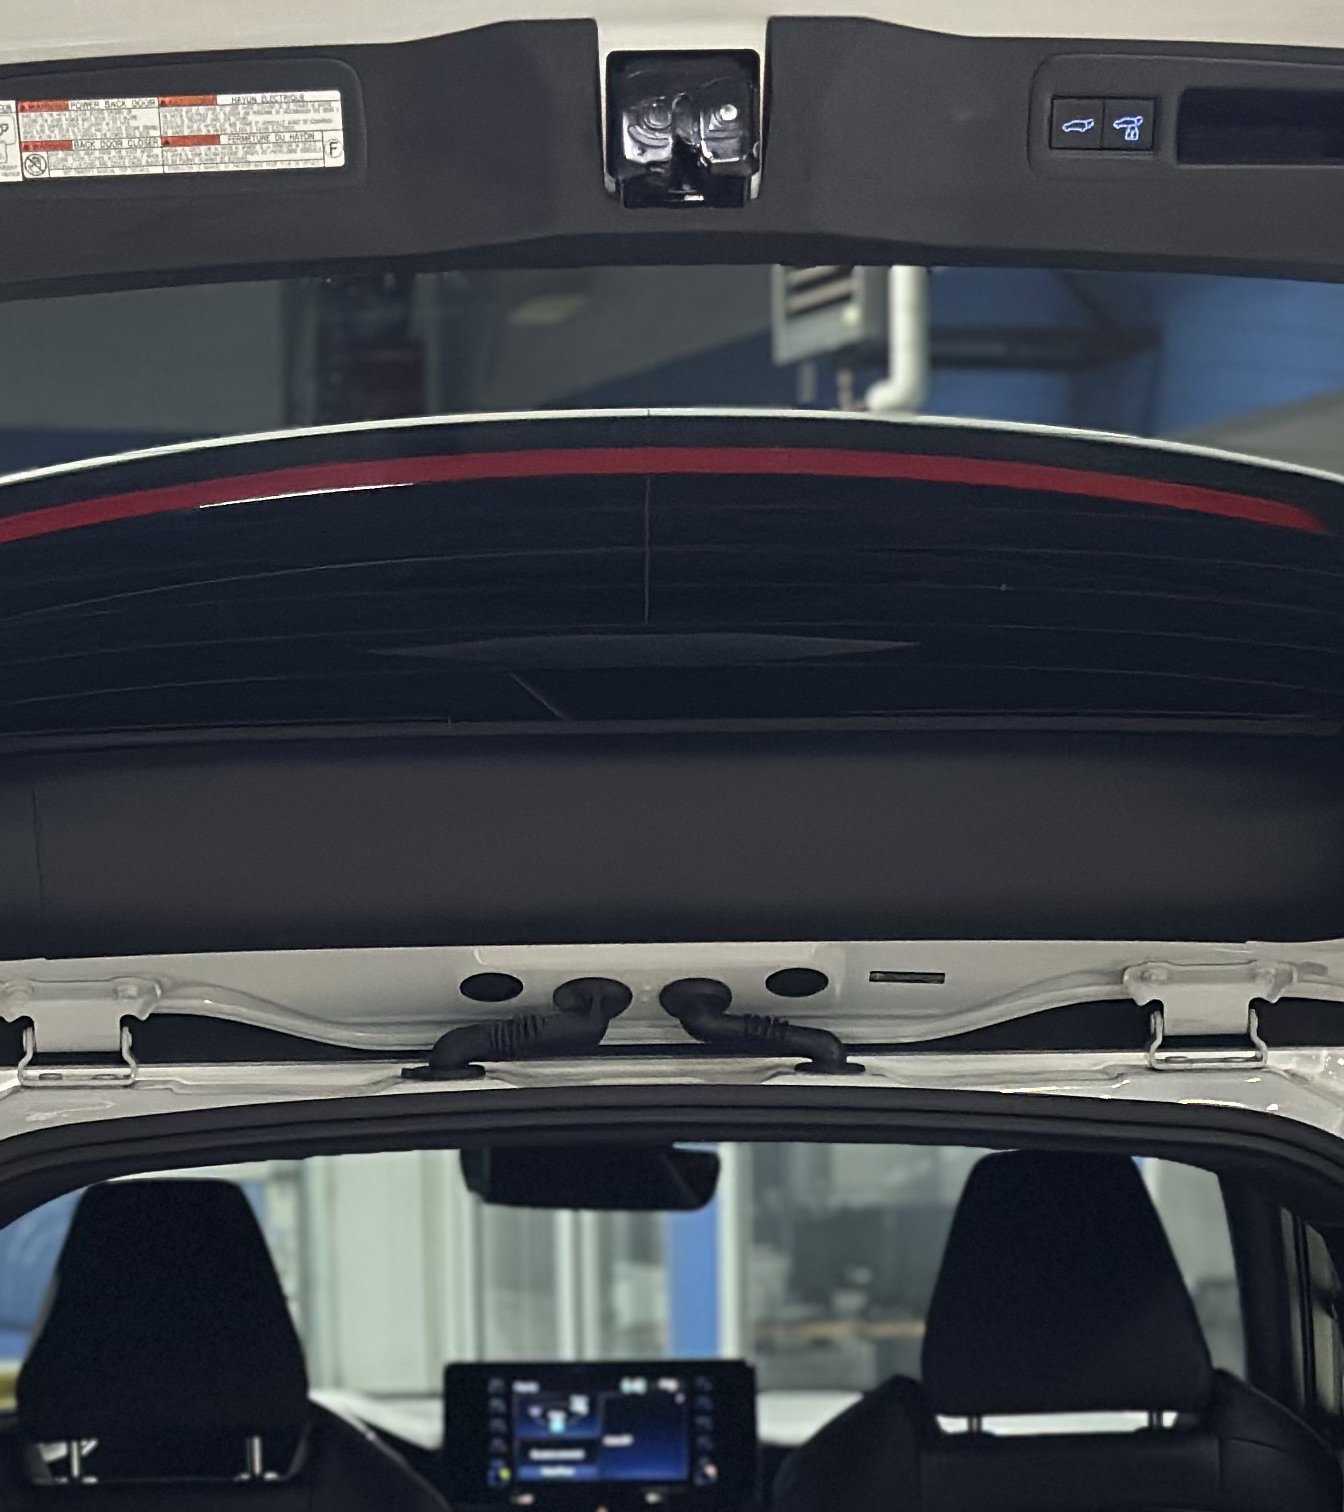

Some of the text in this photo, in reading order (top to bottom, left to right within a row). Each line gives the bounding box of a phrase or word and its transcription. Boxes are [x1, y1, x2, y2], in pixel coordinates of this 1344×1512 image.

[71, 101, 99, 110] POWER
[105, 100, 127, 108] BACK
[131, 99, 156, 108] DOOR
[289, 132, 315, 141] HAYON
[74, 141, 96, 150] BACK
[99, 140, 123, 149] DOOR
[330, 141, 339, 158] F
